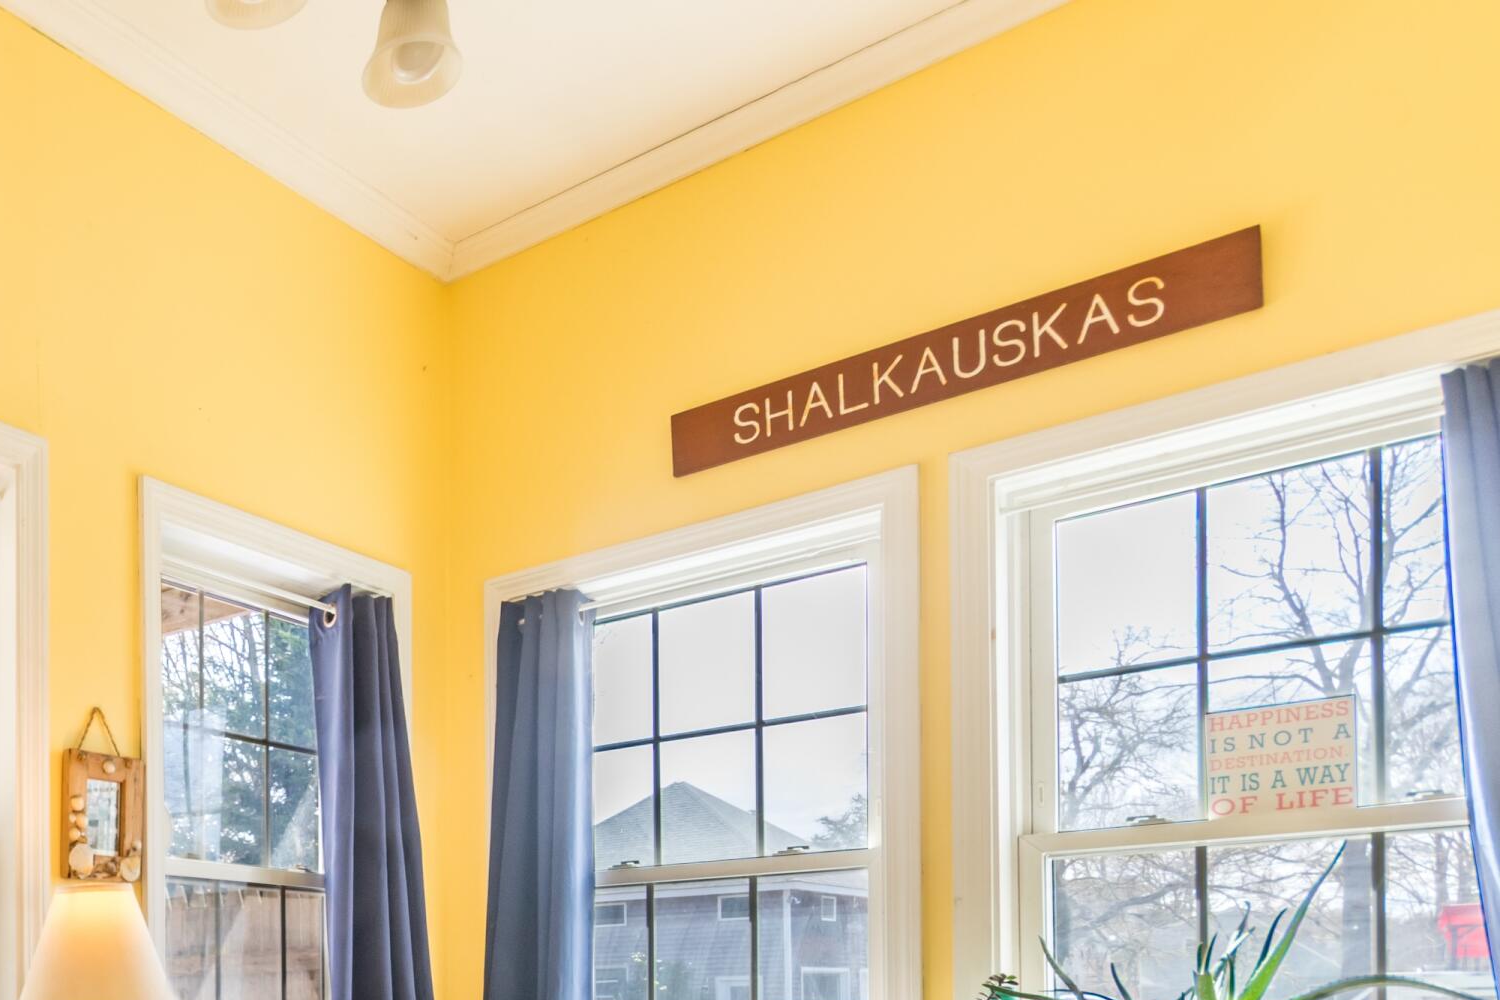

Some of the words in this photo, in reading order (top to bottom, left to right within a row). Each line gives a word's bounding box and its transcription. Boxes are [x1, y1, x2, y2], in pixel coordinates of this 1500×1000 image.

[732, 276, 1166, 445] SHALKAUSKAS
[1209, 700, 1350, 732] HAPPINESS
[1210, 736, 1236, 753] IS
[1248, 728, 1313, 749] NOT
[1332, 723, 1351, 740] A
[1210, 776, 1230, 795] IT
[1241, 773, 1260, 791] IS
[1271, 770, 1286, 789] A
[1296, 763, 1350, 785] WAY
[1211, 796, 1258, 816] OF
[1275, 786, 1353, 811] LIFE
